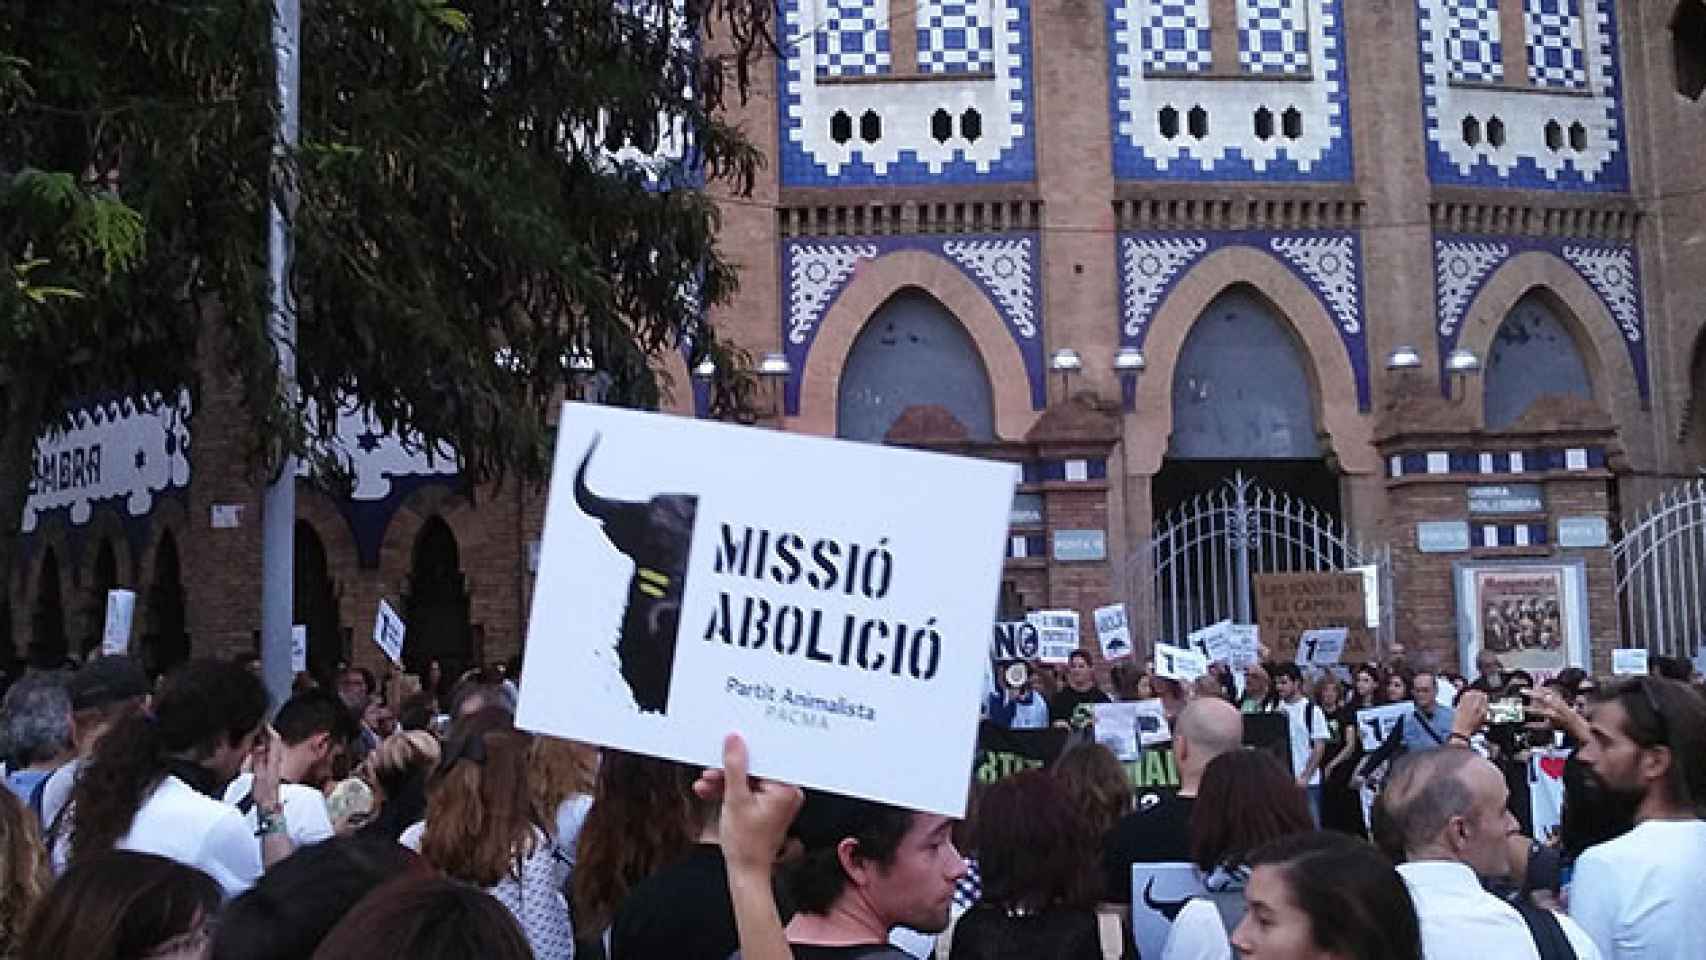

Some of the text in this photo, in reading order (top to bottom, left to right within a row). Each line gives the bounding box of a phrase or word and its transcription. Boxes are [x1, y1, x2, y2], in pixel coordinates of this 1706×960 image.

[714, 521, 893, 599] MISSIÓ
[703, 591, 942, 680] ABOLICIÓ
[726, 676, 777, 701] Partit
[779, 688, 877, 721] Animalista
